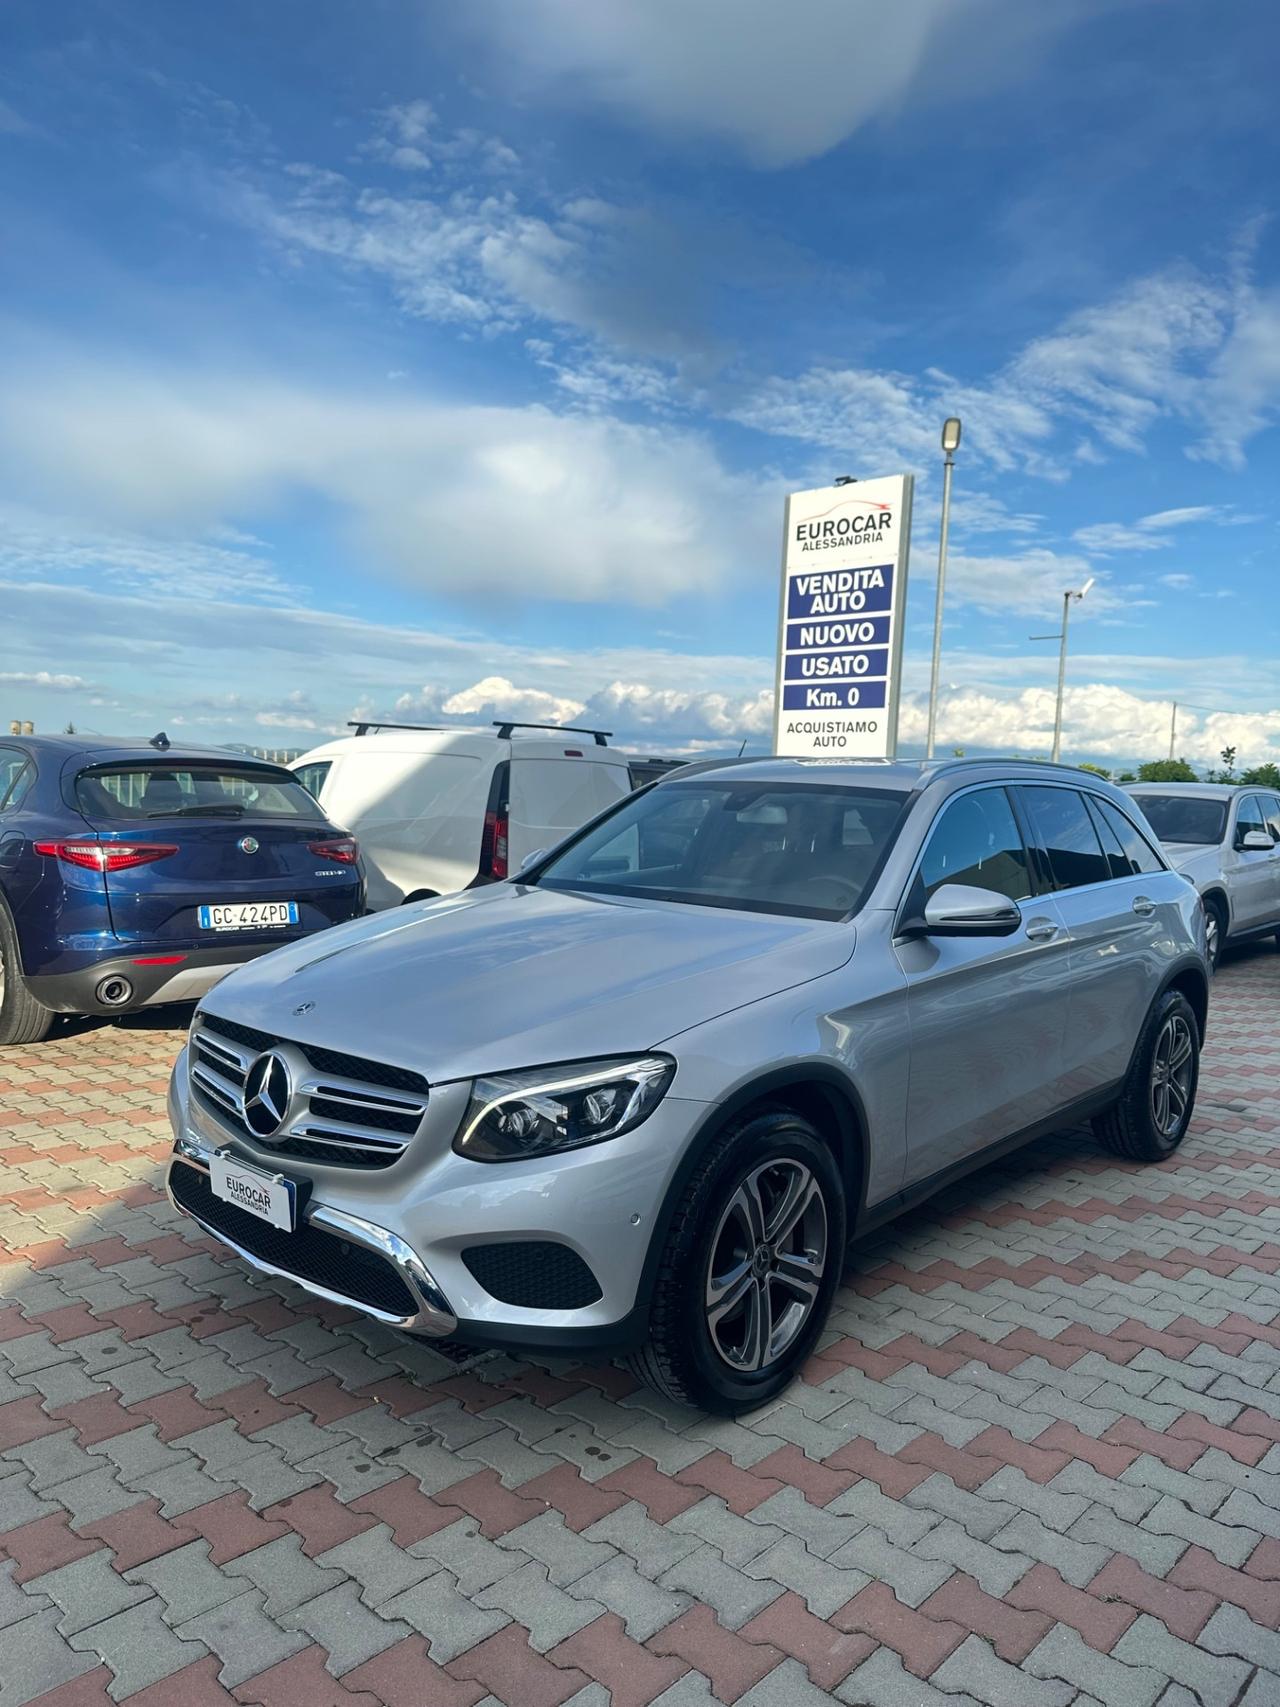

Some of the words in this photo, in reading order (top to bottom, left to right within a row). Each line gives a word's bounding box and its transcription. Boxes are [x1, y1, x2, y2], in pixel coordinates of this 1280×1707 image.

[796, 512, 892, 541] EUROCAR
[802, 532, 883, 552] ALESSANDRIA
[796, 569, 884, 596] VENDITA
[810, 591, 866, 615] AUTO
[800, 622, 875, 646] NUOVO
[801, 654, 870, 677] USATO
[806, 688, 843, 707] Km.
[848, 687, 859, 706] 0
[787, 720, 878, 735] ACQUISTIAMO
[813, 736, 847, 748] AUTO
[226, 1176, 271, 1209] EUROCAR
[230, 1191, 269, 1215] ALESSANDRIA
